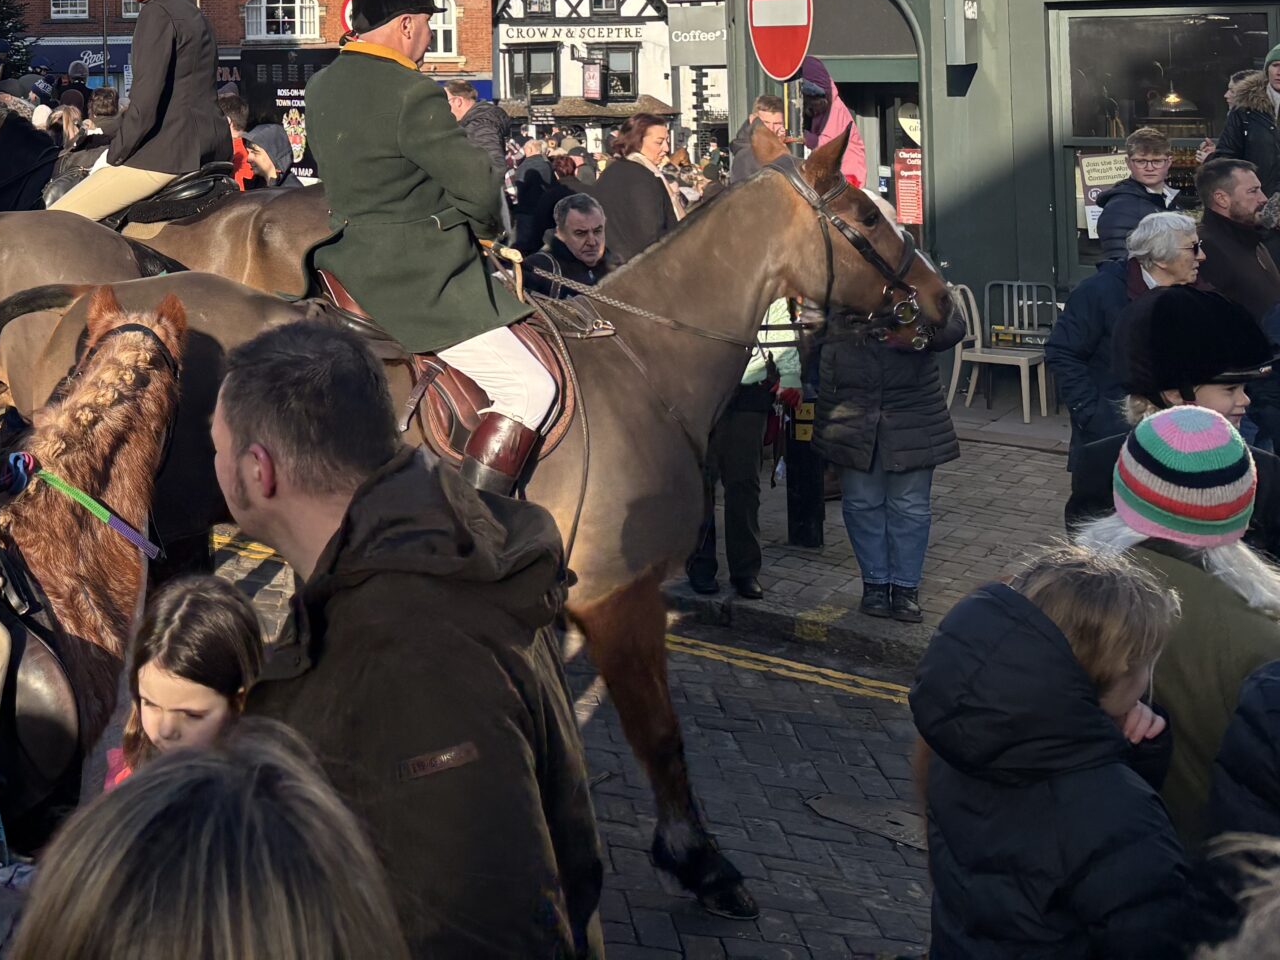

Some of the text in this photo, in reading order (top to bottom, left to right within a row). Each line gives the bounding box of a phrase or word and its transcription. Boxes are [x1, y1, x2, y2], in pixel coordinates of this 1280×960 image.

[506, 26, 643, 39] CROWN & SCEPTRE
[276, 99, 291, 107] TOWN
[298, 167, 314, 177] MAP
